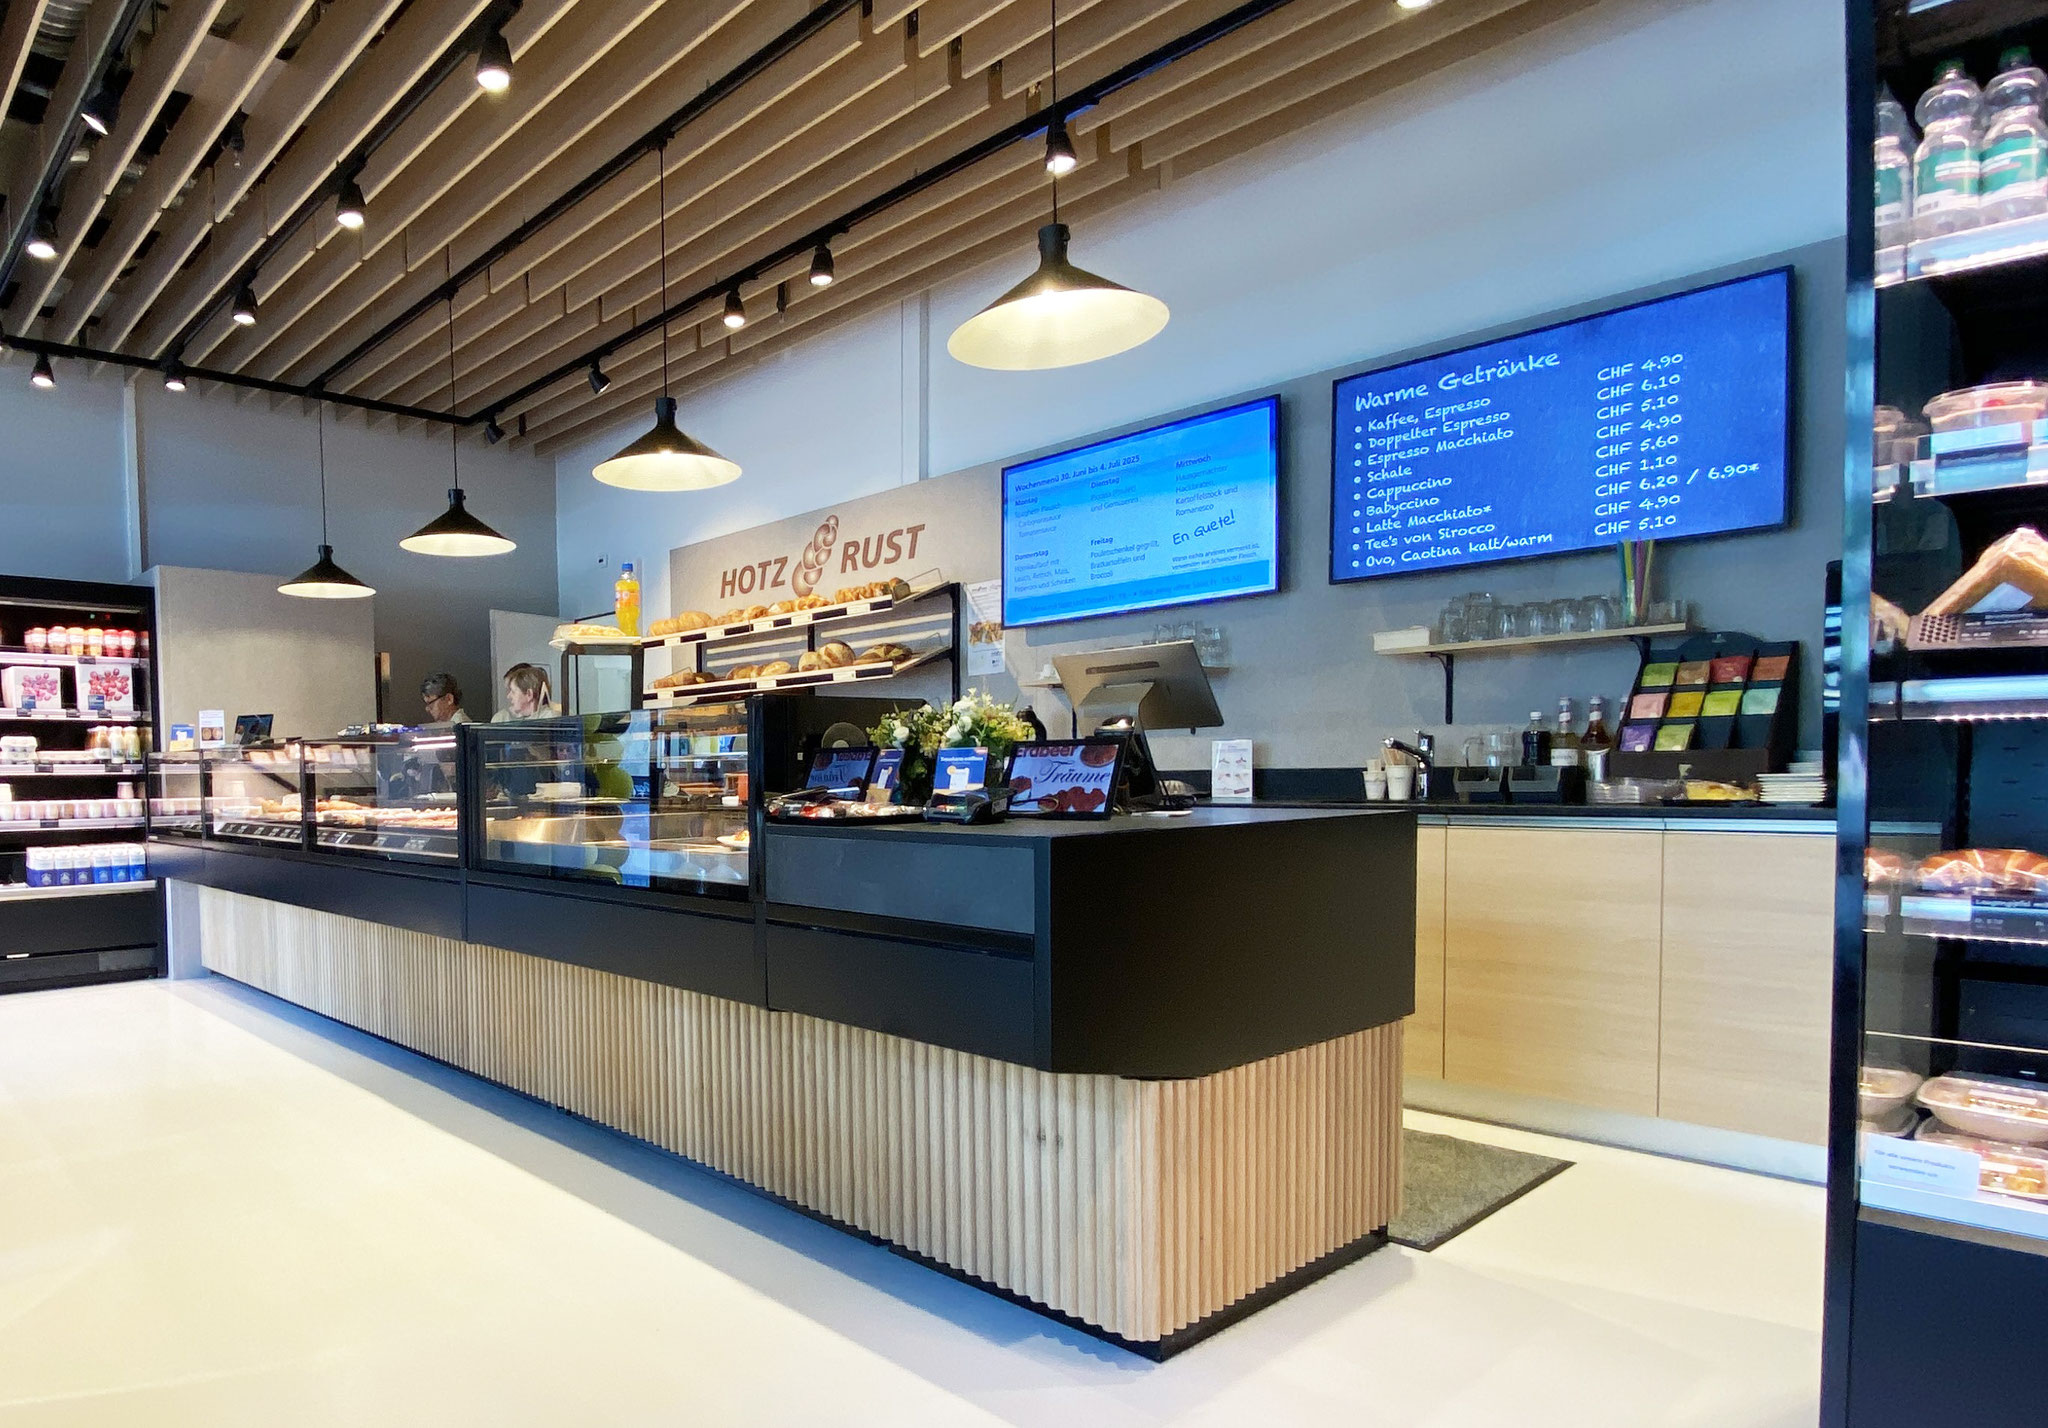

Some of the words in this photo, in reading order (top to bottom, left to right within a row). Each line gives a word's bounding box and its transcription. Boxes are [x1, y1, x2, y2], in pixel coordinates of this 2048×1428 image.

[1355, 384, 1429, 412] Warme
[1438, 352, 1560, 391] Getränke
[1368, 412, 1419, 432] Kaffee,
[1425, 397, 1491, 422] Espresso
[1596, 363, 1634, 381] CHF
[1641, 353, 1684, 372] 4.90
[1367, 446, 1430, 469] Espresso
[1436, 428, 1515, 453] Macchiato
[1596, 403, 1634, 420] CHF
[1640, 394, 1679, 412] 5.10
[1368, 426, 1437, 451] Doppelter
[1443, 412, 1511, 436] Espresso
[1596, 383, 1634, 400] CHF
[1641, 374, 1681, 391] 6.10
[1014, 474, 1060, 492] Wochenmenü
[1072, 467, 1087, 478] Juni
[1088, 465, 1099, 475] bis
[1100, 463, 1107, 471] 4.
[1108, 459, 1121, 469] Juli
[1122, 455, 1141, 466] 2025
[1366, 476, 1453, 501] Cappuccino
[1595, 442, 1633, 459] CHF
[1640, 435, 1679, 452] 5.60
[1367, 465, 1413, 483] Schale
[1596, 422, 1633, 439] CHF
[1640, 414, 1682, 431] 4.90
[1090, 477, 1120, 489] Dienstag
[1223, 485, 1239, 495] und
[1366, 496, 1440, 518] Babyccino
[1595, 461, 1632, 478] CHF
[1639, 455, 1678, 471] 1.10
[1366, 520, 1402, 534] Latte
[1595, 481, 1632, 497] CHF
[1639, 475, 1678, 490] 6.20
[1686, 468, 1700, 485] /
[1090, 536, 1114, 546] Freitag
[1172, 532, 1190, 545] En
[1193, 509, 1236, 538] Guete!
[1365, 534, 1398, 551] Tee's
[1403, 533, 1433, 545] von
[1438, 523, 1496, 540] Sirocco
[1595, 501, 1632, 516] CHF
[1638, 495, 1681, 511] 4.90
[1366, 555, 1395, 567] Ovo,
[1401, 545, 1462, 562] Caotina
[1469, 533, 1553, 552] kalt/warm
[1594, 520, 1632, 536] CHF
[1638, 515, 1677, 531] 5.10
[720, 556, 788, 599] HOTZ
[840, 524, 926, 574] RUST
[1014, 549, 1049, 561] Donnerstag
[1090, 570, 1114, 581] Broccoli
[1132, 553, 1146, 562] und
[1034, 759, 1111, 784] Träume
